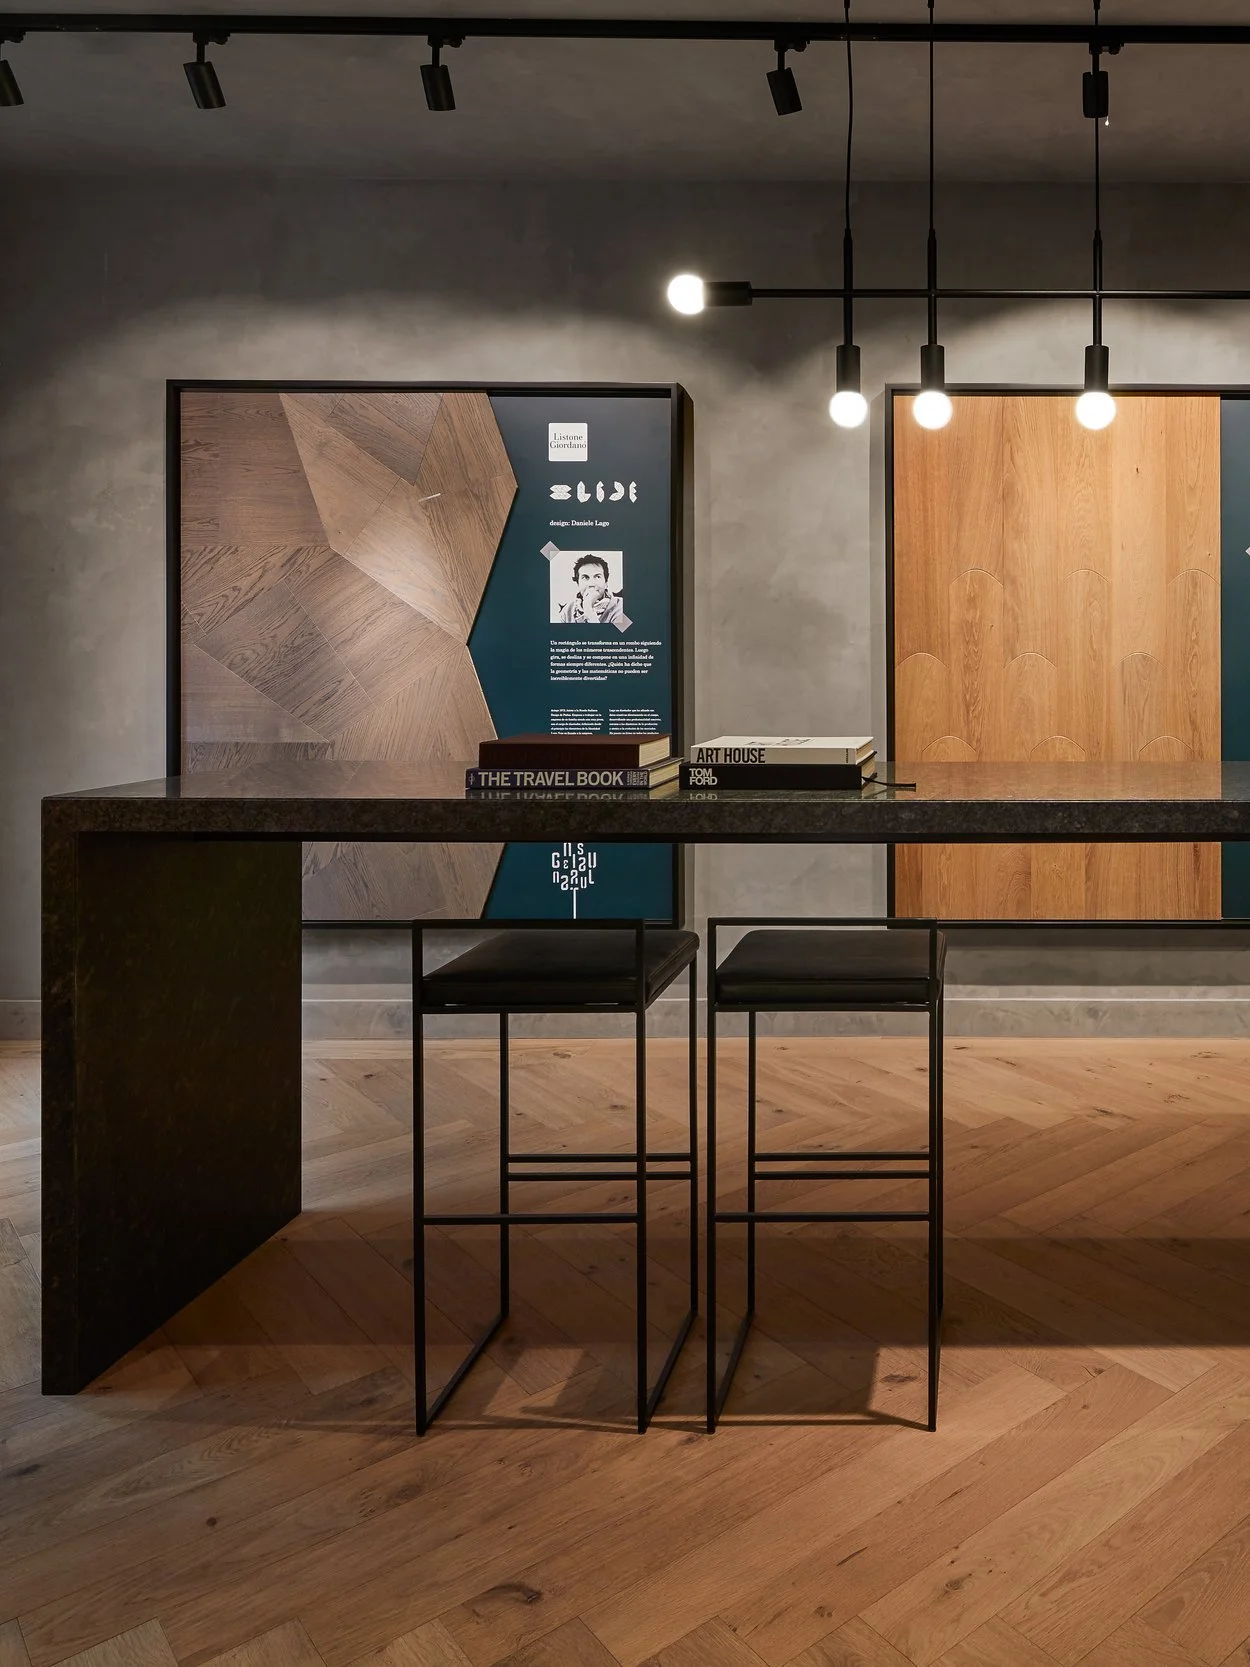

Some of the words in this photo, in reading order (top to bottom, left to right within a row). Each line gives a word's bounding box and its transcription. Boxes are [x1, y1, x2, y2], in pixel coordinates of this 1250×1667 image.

[553, 433, 583, 441] Listone
[549, 440, 587, 449] Giordano
[696, 748, 721, 763] ART
[724, 748, 766, 764] HOUSE
[688, 768, 713, 777] TOM
[478, 771, 511, 786] THE
[513, 771, 576, 786] TRAVEL
[577, 771, 624, 786] BOOK
[689, 777, 718, 785] FORD
